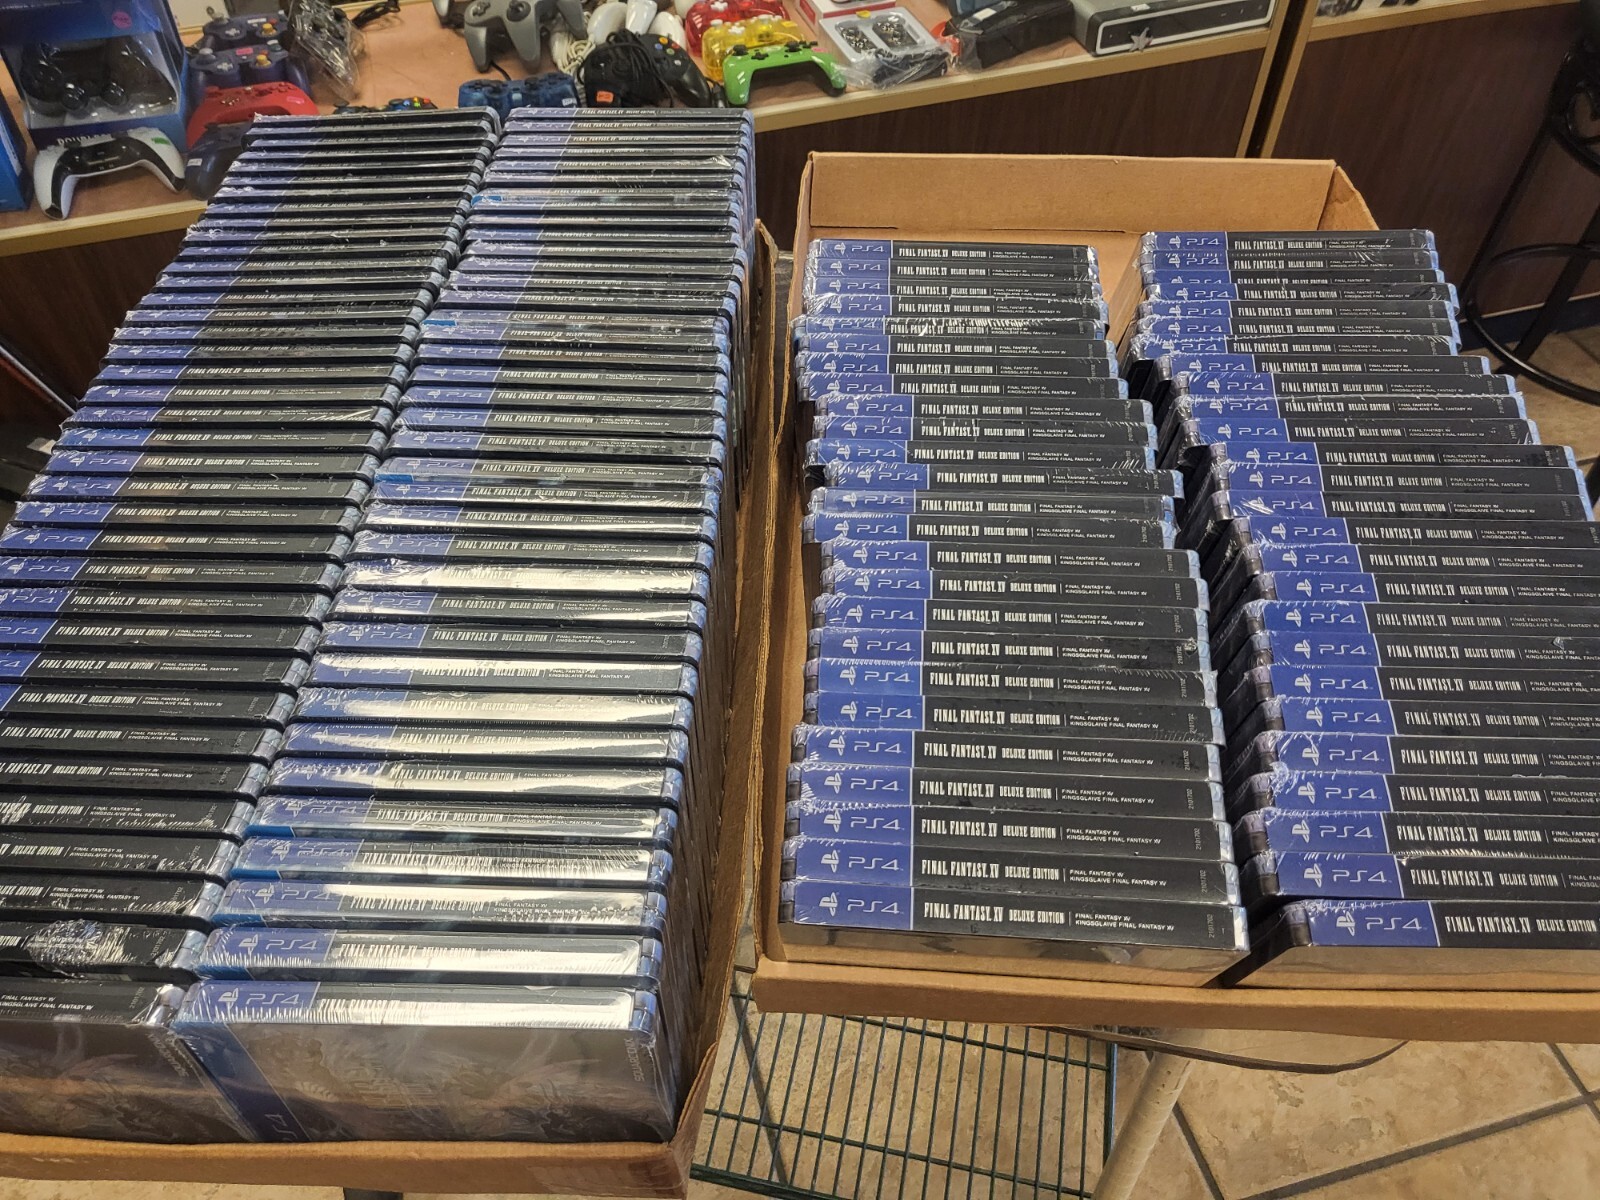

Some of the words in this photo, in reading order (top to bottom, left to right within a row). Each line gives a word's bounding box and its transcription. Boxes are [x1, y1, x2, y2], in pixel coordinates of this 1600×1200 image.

[1186, 237, 1220, 246] PS4
[1234, 240, 1251, 250] FINAL
[1288, 241, 1304, 249] DELUXE
[1306, 241, 1323, 249] EDITION
[851, 245, 884, 253] PS4
[899, 248, 916, 257] FINAL
[952, 249, 968, 257] DELUXE
[846, 343, 881, 352] PS4
[897, 342, 915, 353] FINAL
[943, 343, 951, 353] XV
[955, 344, 972, 353] DELUXE
[974, 344, 993, 353] EDITION
[1227, 382, 1267, 392] PS4
[1281, 381, 1301, 392] FINAL
[1343, 382, 1362, 392] DELUXE
[1364, 383, 1383, 392] EDITION
[866, 404, 903, 413] PS4
[921, 404, 941, 415] FINAL
[970, 405, 978, 415] XV
[982, 405, 1001, 415] DELUXE
[1003, 406, 1022, 415] EDITION
[1271, 475, 1312, 485] PS4
[1330, 475, 1352, 486] FINAL
[1398, 476, 1418, 487] DELUXE
[1421, 476, 1442, 487] EDITION
[370, 632, 413, 641] PS4
[432, 631, 455, 641] FINAL
[501, 632, 524, 642] DELUXE
[525, 633, 549, 642] EDITION
[867, 639, 913, 652] PS4
[931, 641, 955, 656] FINAL
[991, 644, 1001, 656] XV
[1005, 644, 1028, 657] DELUXE
[1030, 645, 1054, 658] EDITION
[1320, 679, 1368, 690] PS4
[1390, 678, 1415, 691] FINAL
[1454, 679, 1464, 691] XV
[1469, 679, 1493, 691] DELUXE
[1496, 680, 1521, 691] EDITION
[854, 741, 901, 755] PS4
[924, 743, 949, 758] FINAL
[951, 744, 987, 759] FANTASY
[987, 745, 997, 759] XV
[1002, 746, 1025, 760] DELUXE
[1028, 747, 1053, 761] EDITION
[850, 817, 900, 831] PS4
[922, 819, 947, 835] FINAL
[950, 820, 987, 836] FANTASY
[987, 822, 998, 837] XV
[1003, 823, 1027, 838] DELUXE
[1030, 825, 1056, 839] EDITION
[847, 899, 899, 914] PS4
[924, 903, 951, 919] FINAL
[953, 904, 992, 920] FANTASY
[992, 906, 1003, 921] XV
[1009, 907, 1034, 922] DELUXE
[1038, 908, 1064, 923] EDITION
[1365, 917, 1421, 930] PS4
[1445, 917, 1474, 932] FINAL
[1519, 918, 1531, 932] XV
[1537, 918, 1564, 932] DELUXE
[1567, 919, 1596, 932] EDITION
[265, 939, 318, 951] PS4
[246, 993, 301, 1005] PS4
